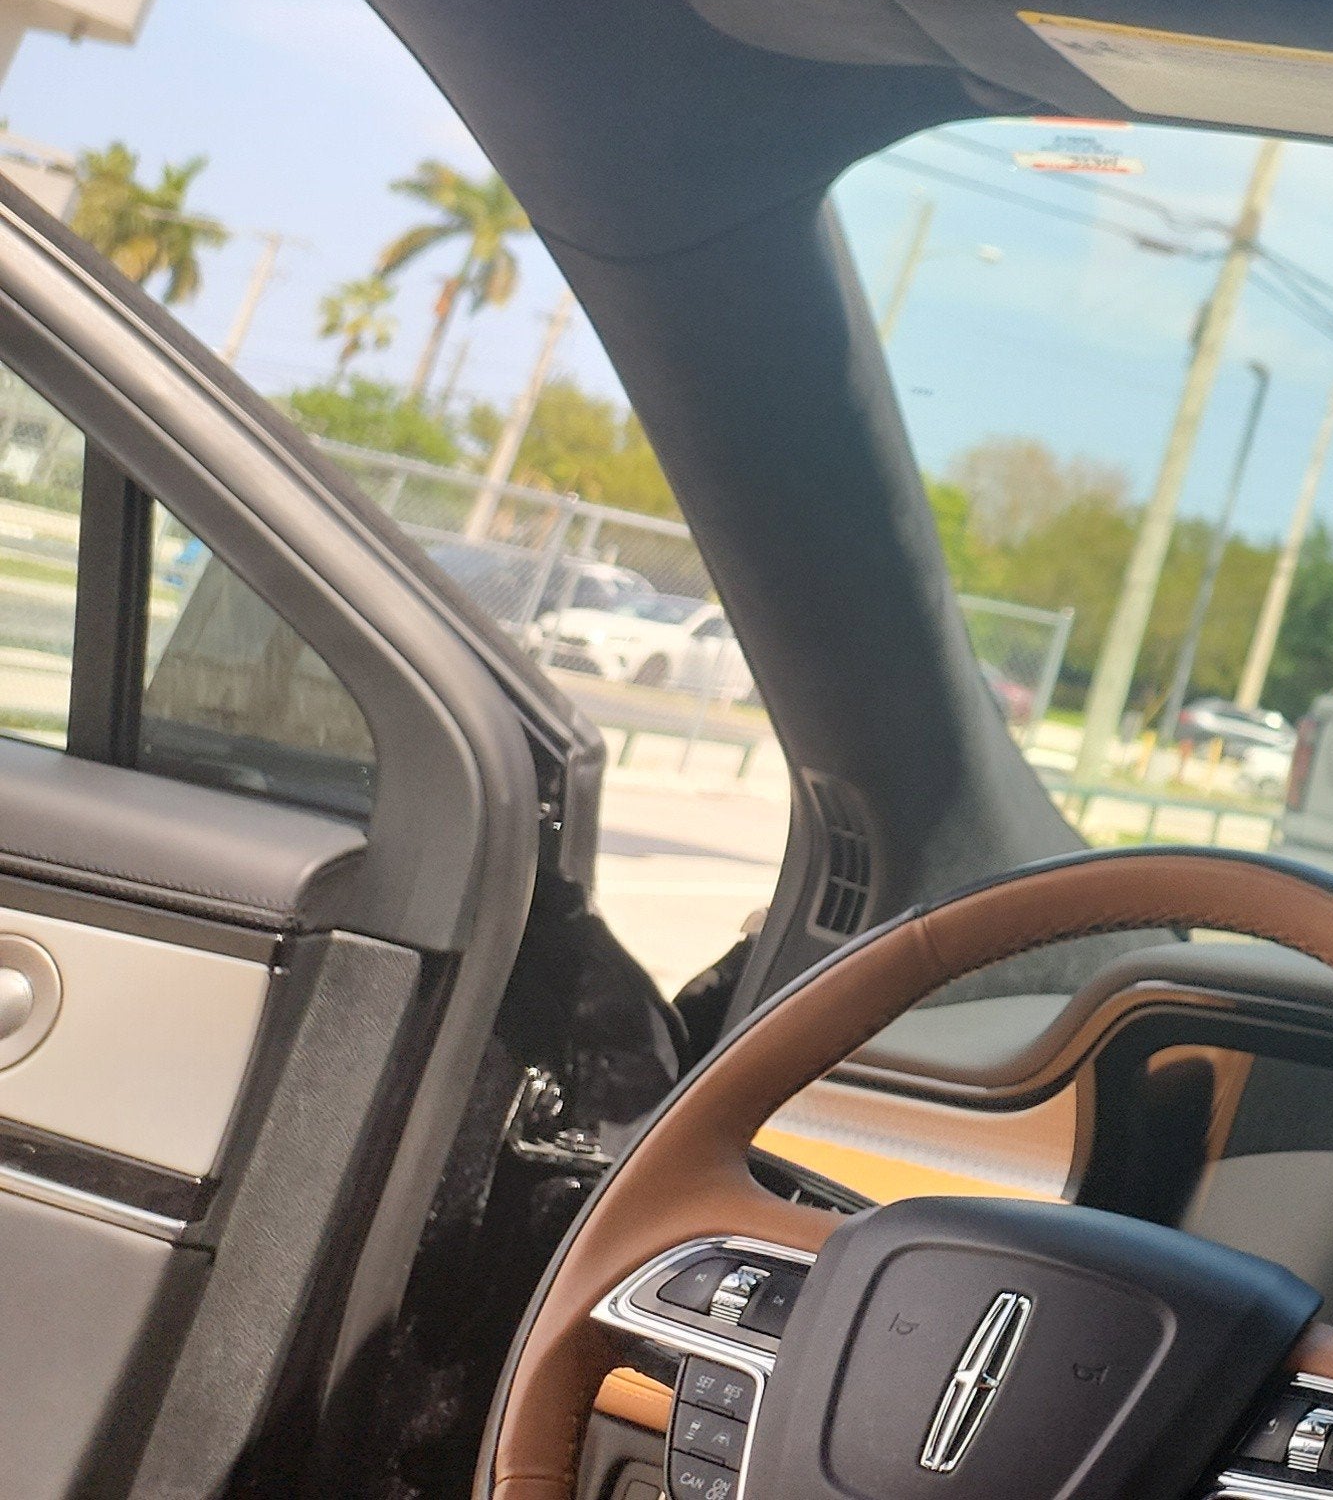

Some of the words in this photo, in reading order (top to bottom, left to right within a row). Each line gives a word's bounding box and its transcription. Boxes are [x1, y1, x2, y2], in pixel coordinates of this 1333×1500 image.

[695, 1374, 716, 1389] SET
[723, 1382, 744, 1400] RES
[679, 1471, 705, 1489] CAN
[712, 1477, 731, 1492] ON
